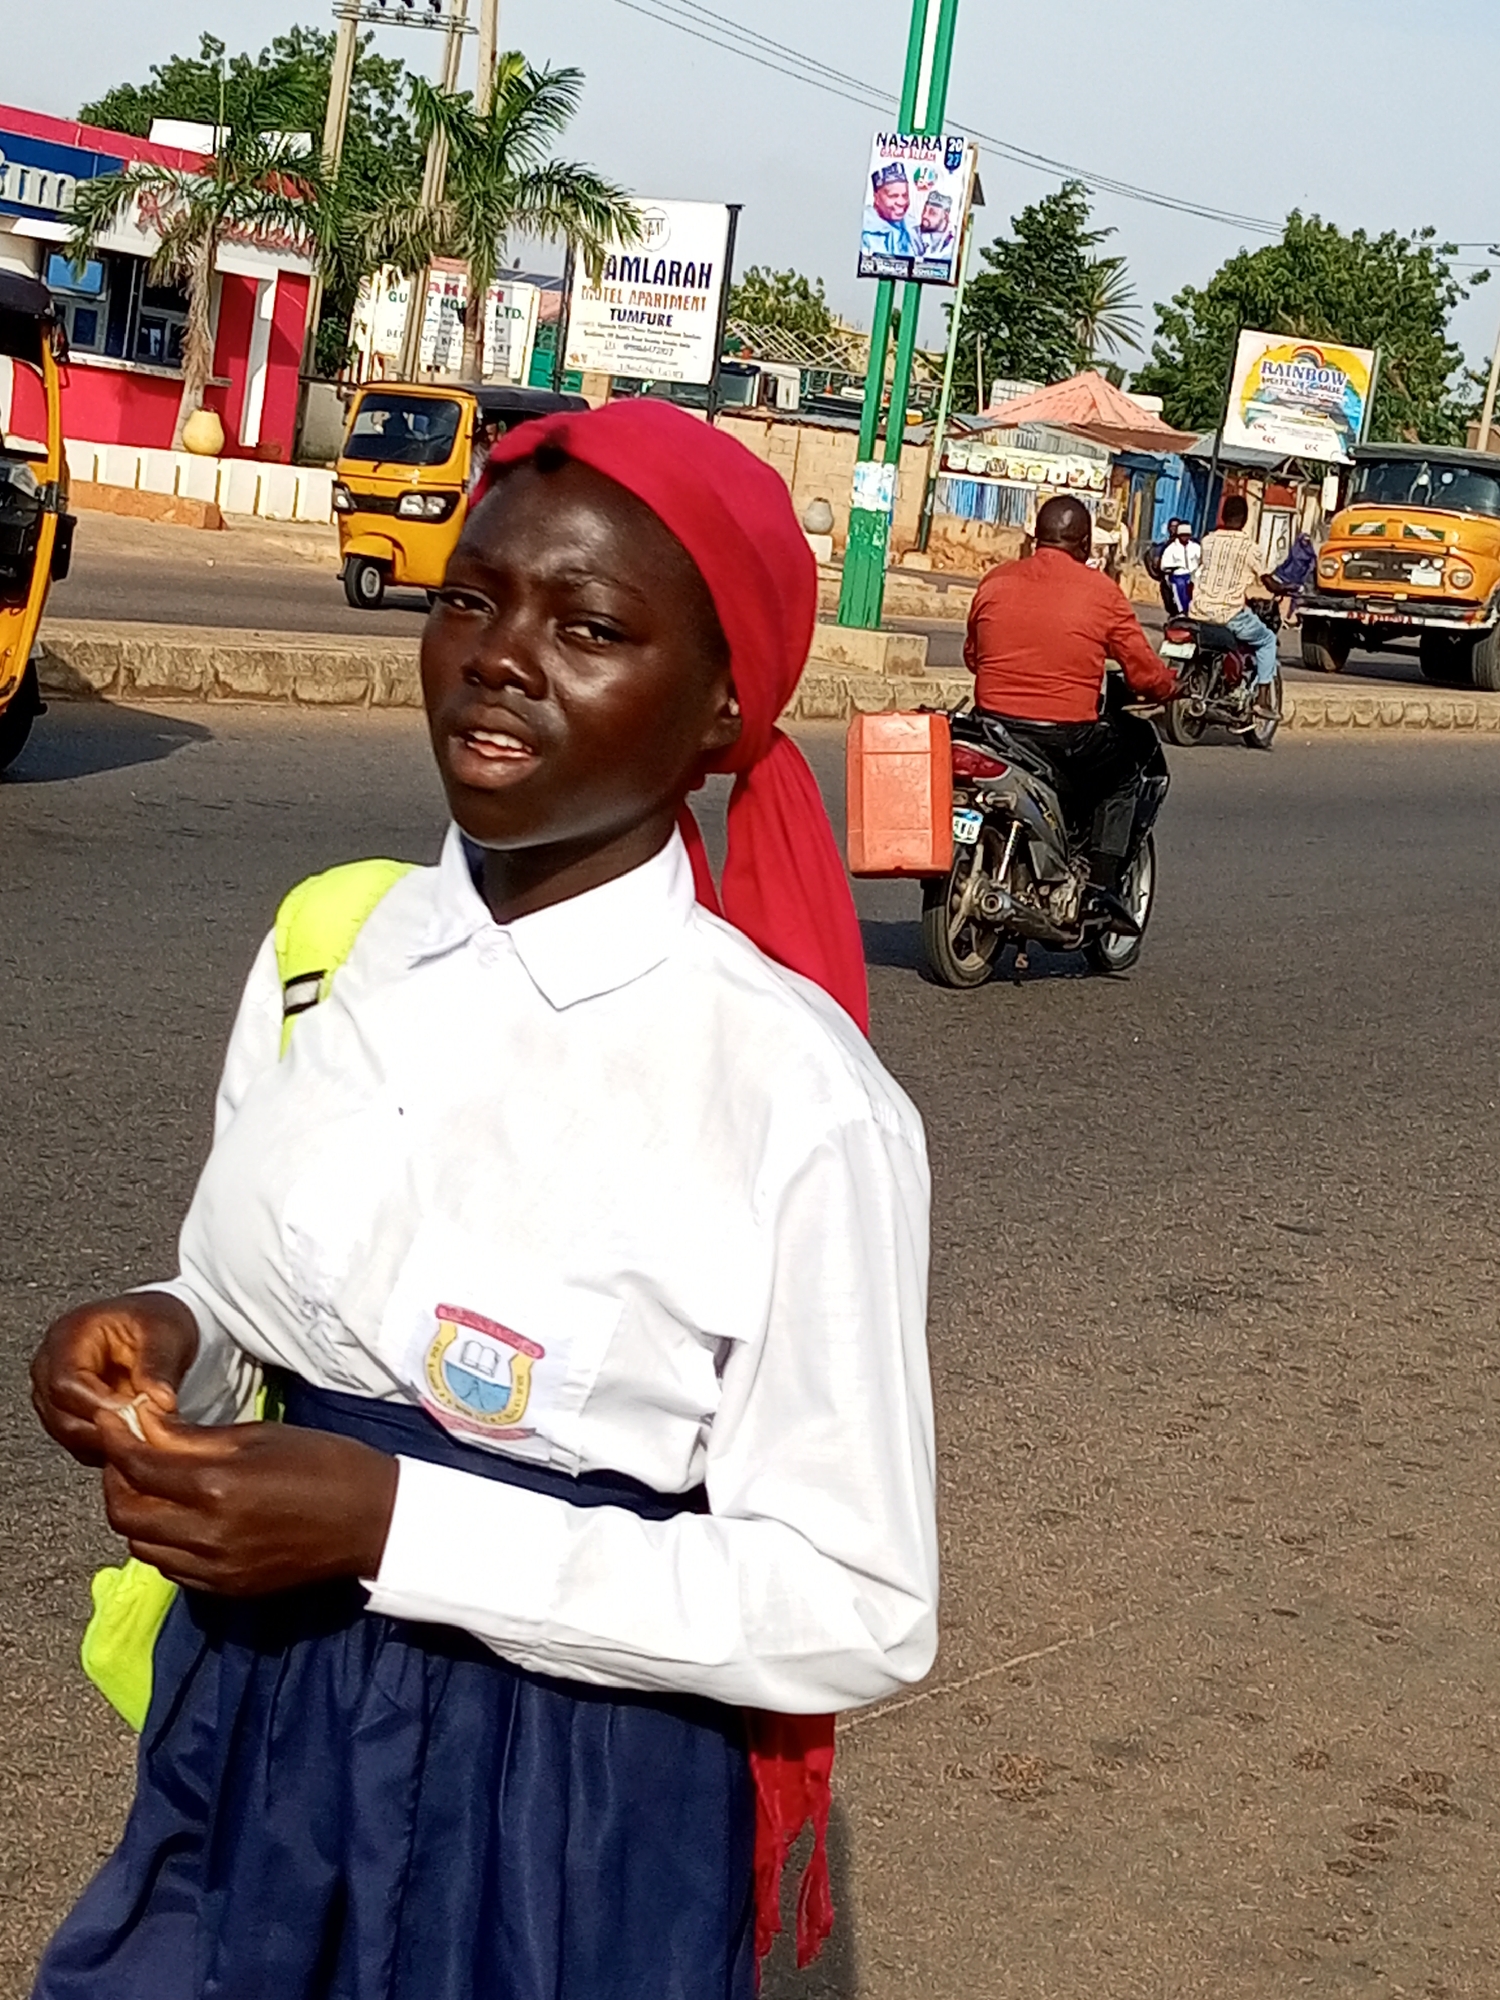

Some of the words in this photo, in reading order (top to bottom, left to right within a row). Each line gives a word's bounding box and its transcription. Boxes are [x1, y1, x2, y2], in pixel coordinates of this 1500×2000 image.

[876, 131, 943, 152] NASARA
[947, 138, 963, 152] 20
[946, 153, 961, 167] 27
[603, 254, 714, 290] AMLARAH
[388, 290, 435, 307] GUT
[628, 289, 707, 312] APARTMENT
[609, 308, 674, 328] TUMFURE
[1260, 360, 1347, 386] RAINBOW
